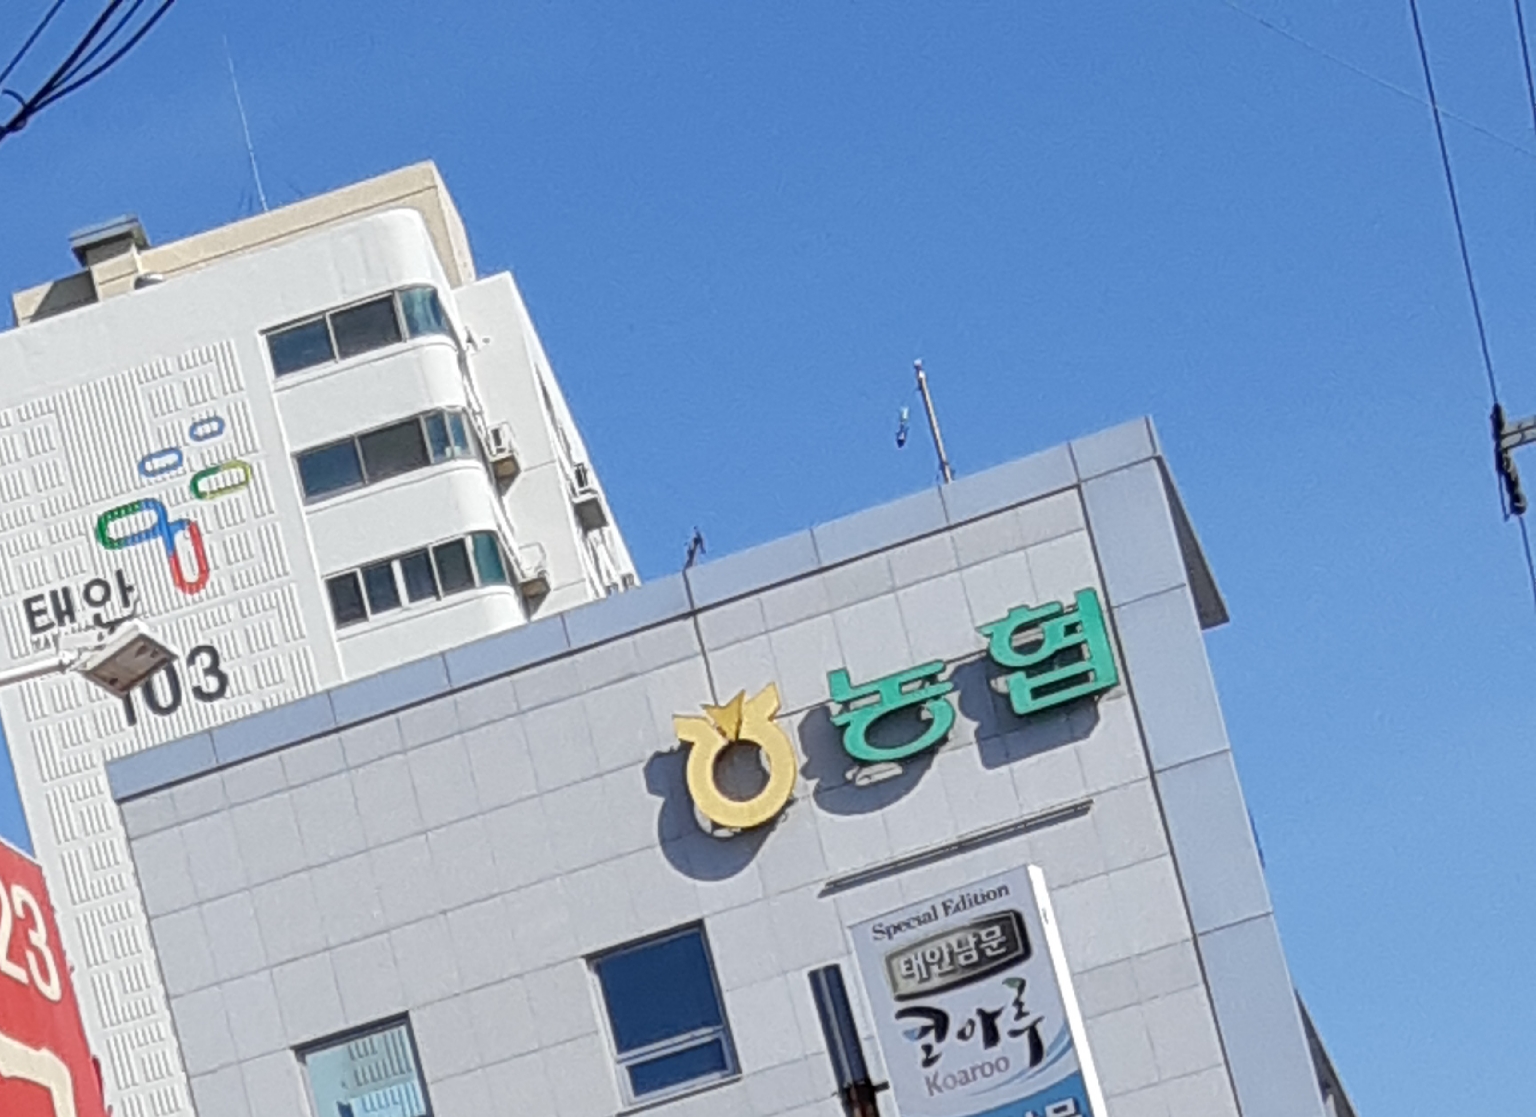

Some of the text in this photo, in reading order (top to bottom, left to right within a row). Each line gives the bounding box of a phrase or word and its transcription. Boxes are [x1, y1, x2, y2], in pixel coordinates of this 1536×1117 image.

[122, 644, 229, 727] 103
[828, 586, 1120, 763] 농협
[871, 884, 1011, 942] Special Edition
[900, 925, 1008, 984] 태안남문
[924, 1055, 1011, 1097] Koaroo
